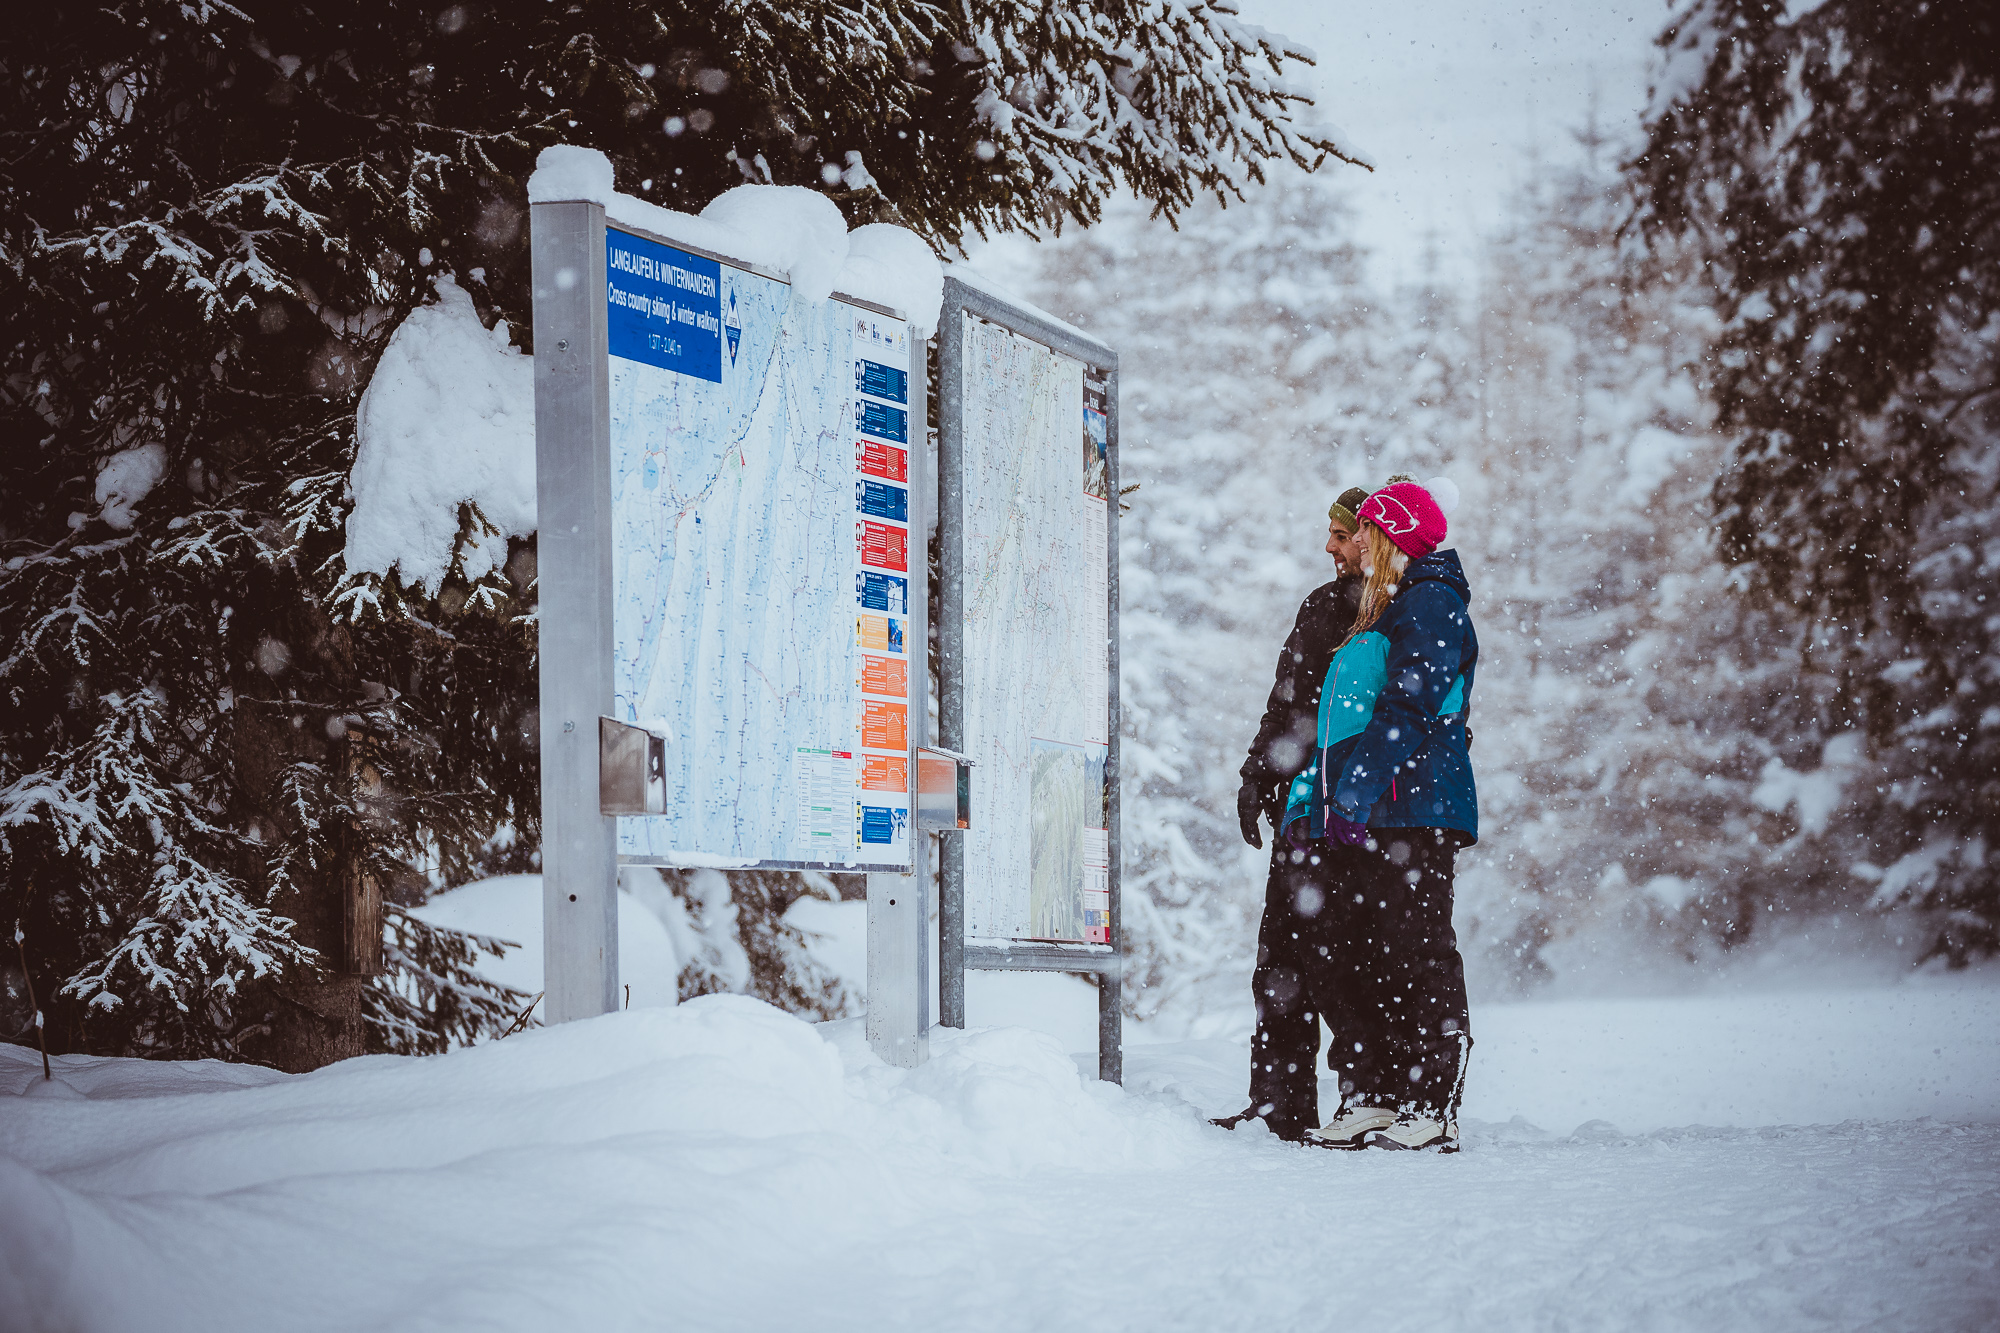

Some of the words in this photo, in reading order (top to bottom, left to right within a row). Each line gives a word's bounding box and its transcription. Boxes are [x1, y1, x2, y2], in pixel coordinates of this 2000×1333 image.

[609, 246, 654, 279] LANGLAUFEN
[655, 261, 660, 281] &
[661, 262, 716, 298] WINTERWANDERN
[608, 281, 627, 307] Cross
[628, 293, 651, 318] country
[652, 296, 671, 324] skiing
[671, 300, 676, 321] &
[677, 304, 696, 326] winter
[696, 310, 719, 338] walking
